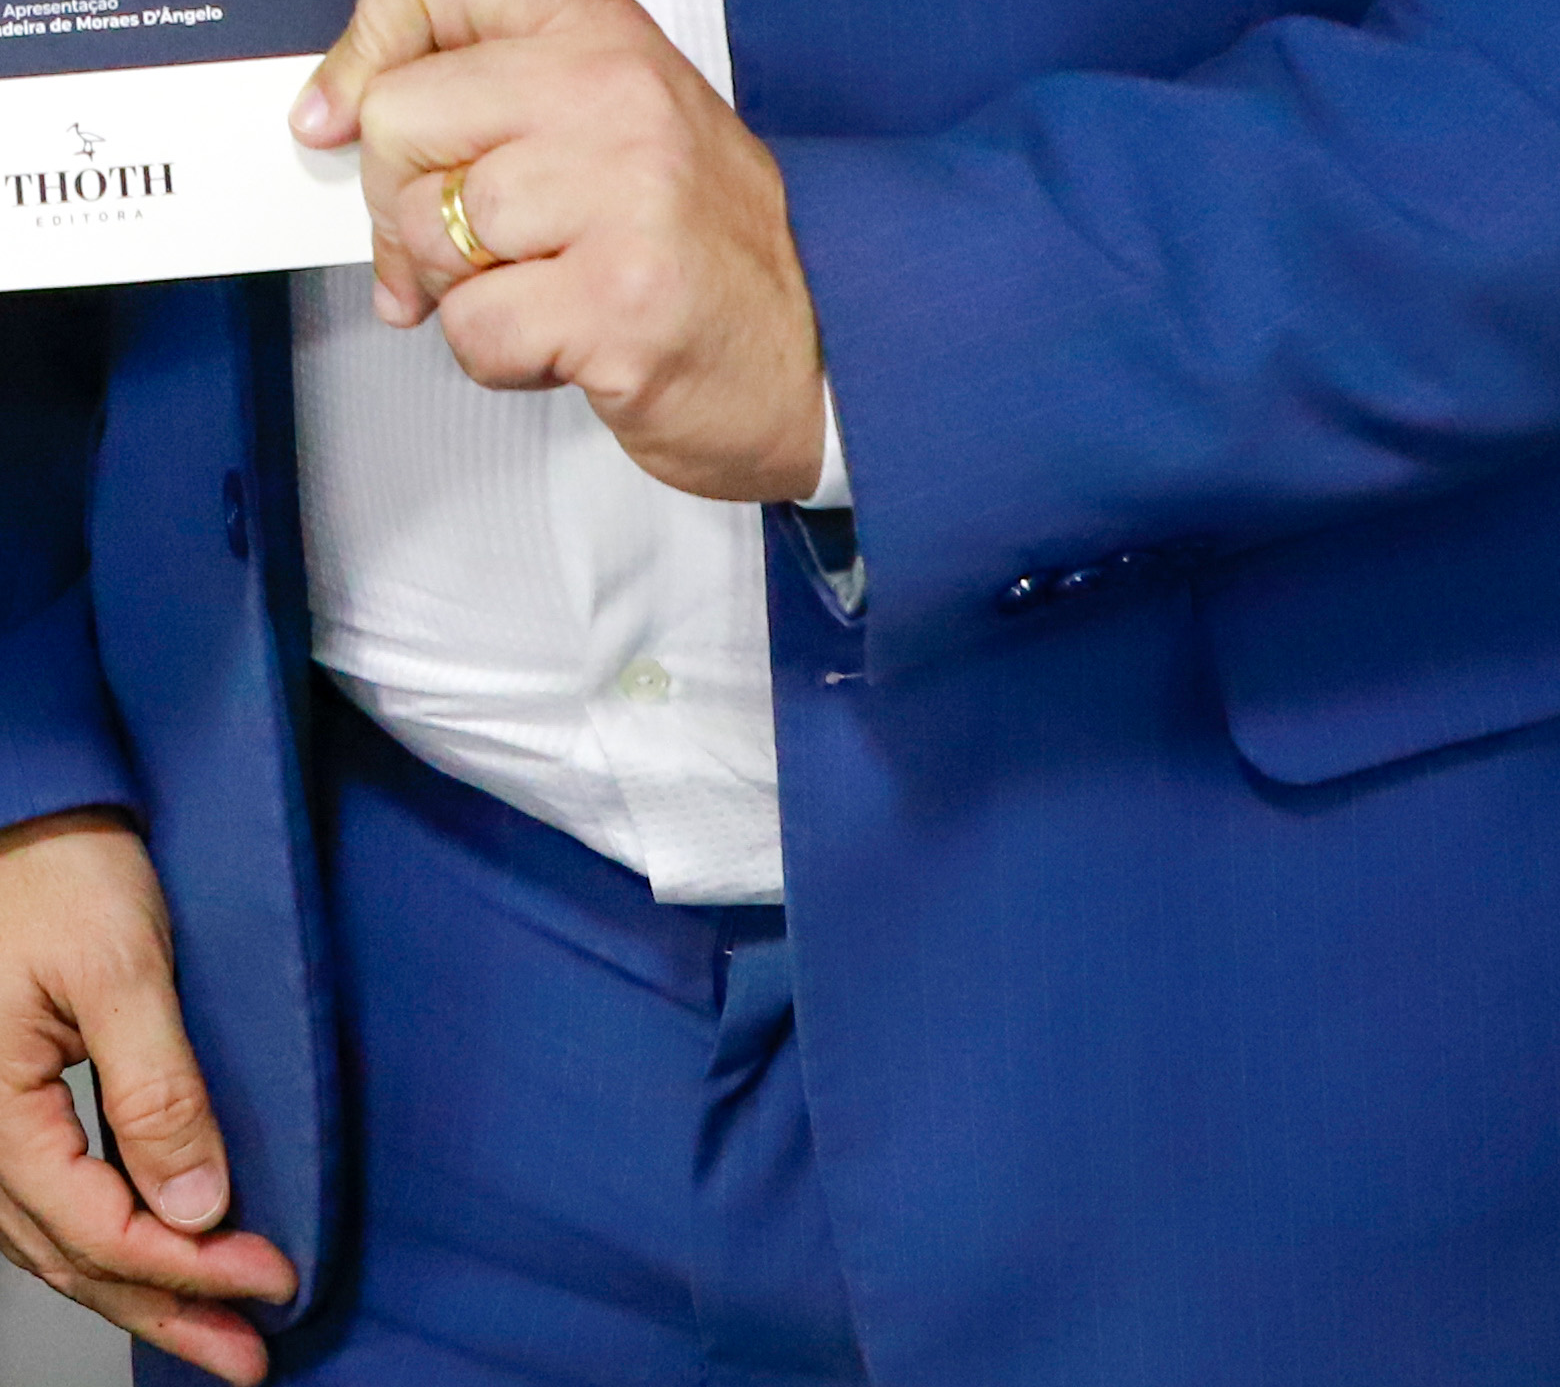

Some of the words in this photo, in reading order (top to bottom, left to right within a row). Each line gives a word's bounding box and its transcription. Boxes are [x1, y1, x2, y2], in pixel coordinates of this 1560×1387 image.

[49, 15, 72, 33] de
[76, 12, 140, 30] Moraes
[143, 4, 223, 26] D'Ângelo
[4, 162, 177, 207] THOTH
[35, 208, 144, 228] EDITORA
